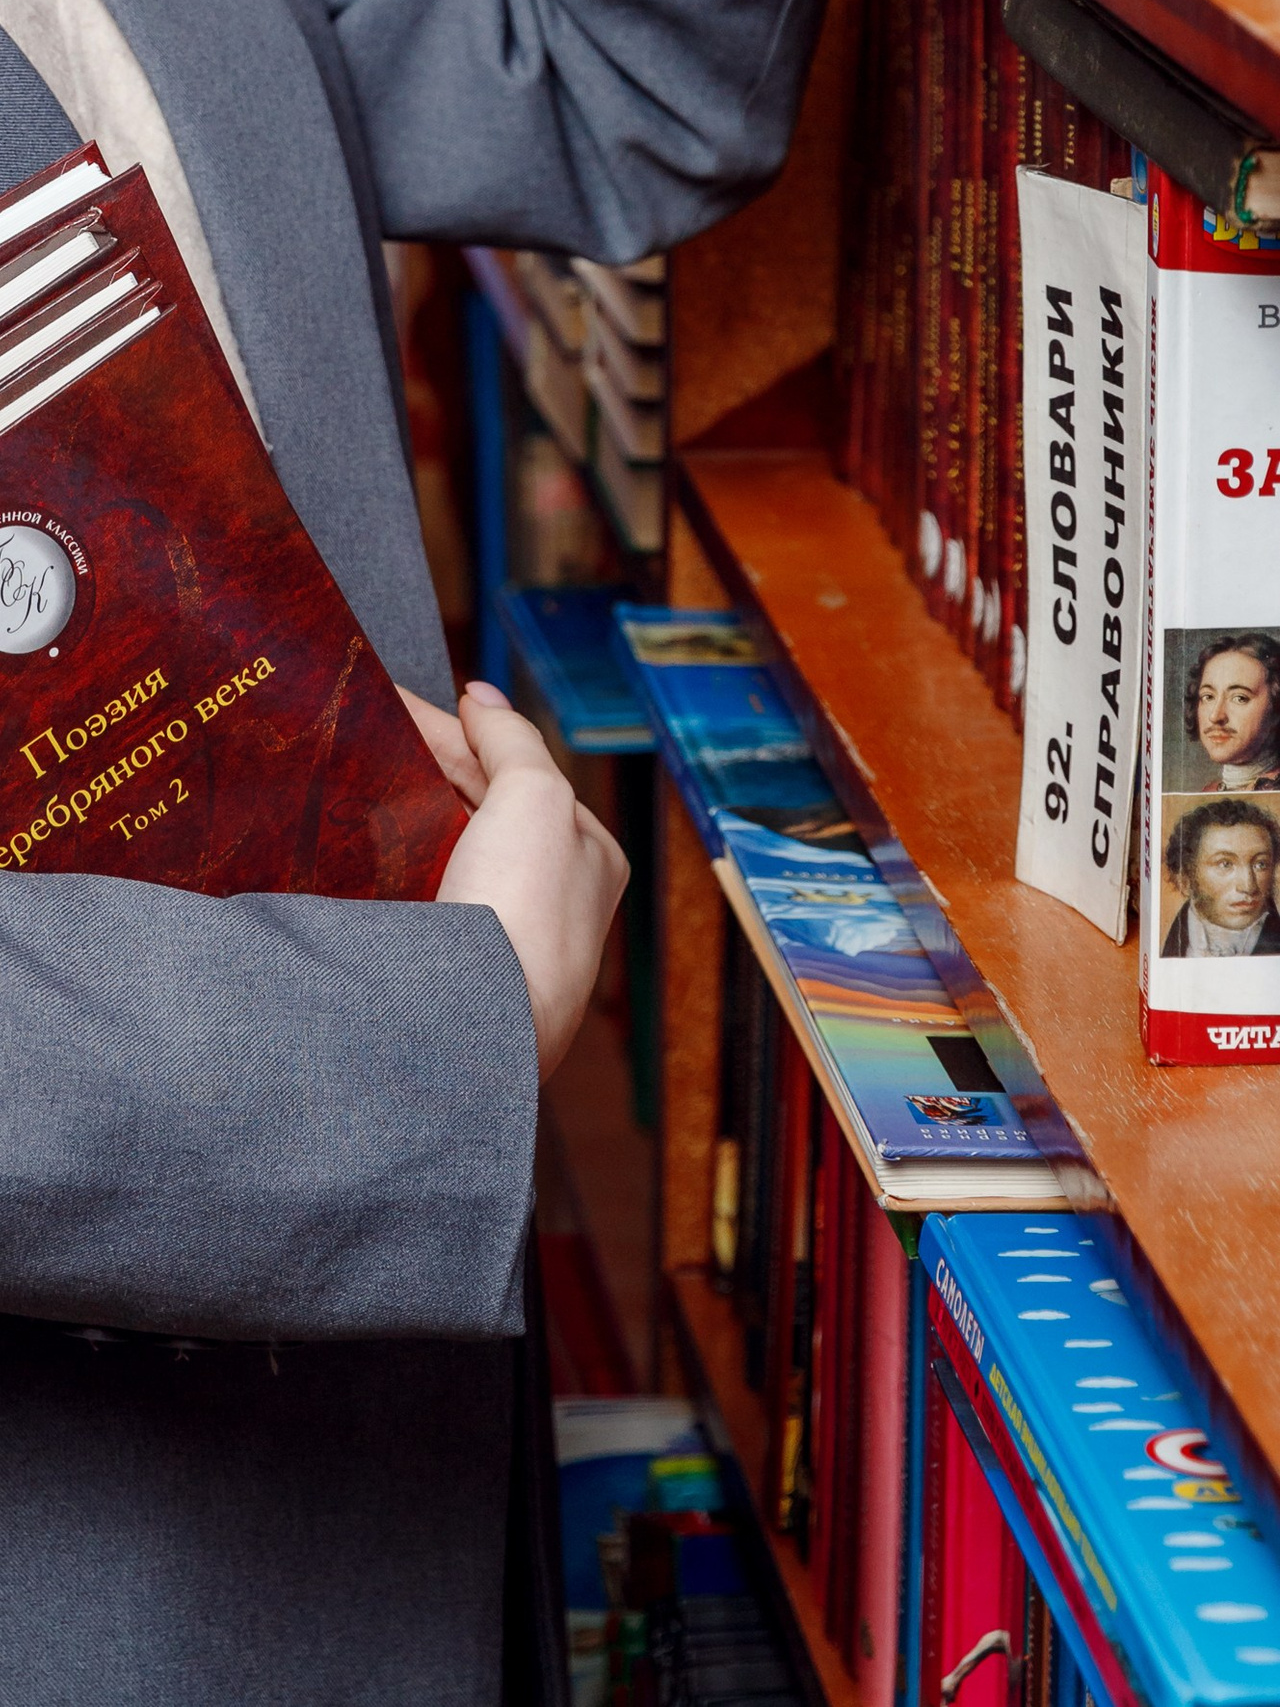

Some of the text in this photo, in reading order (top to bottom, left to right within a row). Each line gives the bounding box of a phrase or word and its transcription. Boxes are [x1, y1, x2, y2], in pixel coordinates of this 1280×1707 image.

[45, 519, 89, 576] КЛАССИКИ
[1044, 284, 1078, 825] 92. СЛОВАРИ
[1091, 285, 1125, 870] СПРАВОЧНИКИ
[1145, 436, 1156, 761] ЗАМЕЧАТЕЛЬНЫХ
[19, 667, 169, 780] Поэзия
[193, 656, 277, 724] века
[109, 778, 190, 842] Том 2
[1144, 766, 1152, 883] ДЕТЕЙ
[935, 1257, 985, 1365] САМОЛЕТЫ
